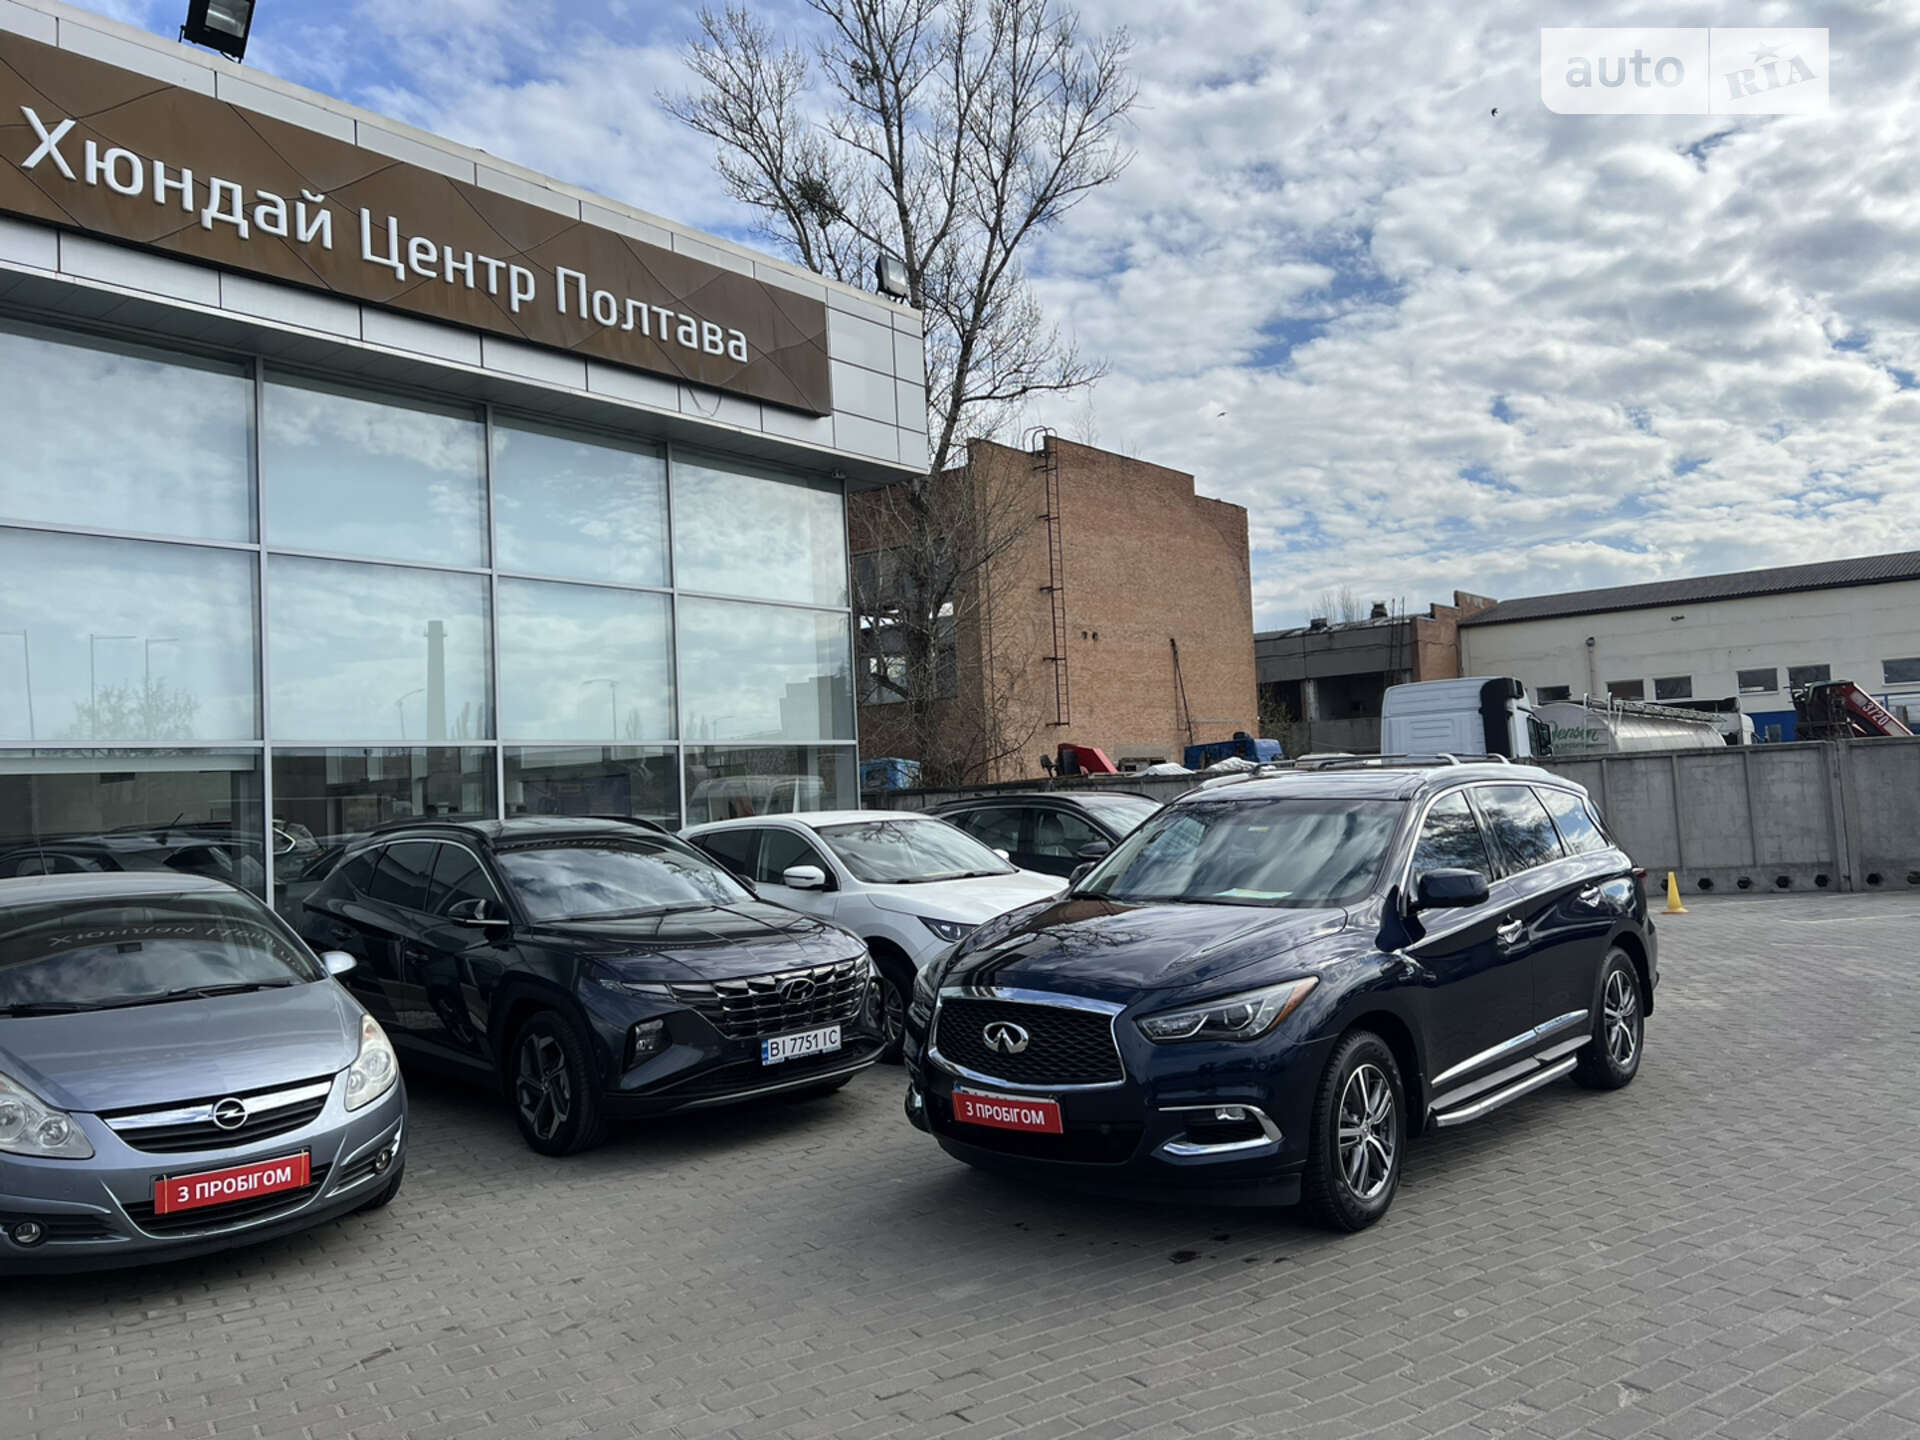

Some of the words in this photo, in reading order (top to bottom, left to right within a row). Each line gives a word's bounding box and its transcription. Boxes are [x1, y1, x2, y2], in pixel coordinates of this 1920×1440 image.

[20, 105, 333, 250] Хюндай
[360, 207, 536, 314] Центр
[556, 265, 749, 363] Полтава
[1862, 702, 1890, 727] 3720
[769, 1039, 786, 1058] BI
[790, 1032, 819, 1054] 7751
[823, 1029, 838, 1047] IC
[976, 1103, 1046, 1126] ПРОБІГОМ
[195, 1166, 292, 1201] ПРОБІГОМ
